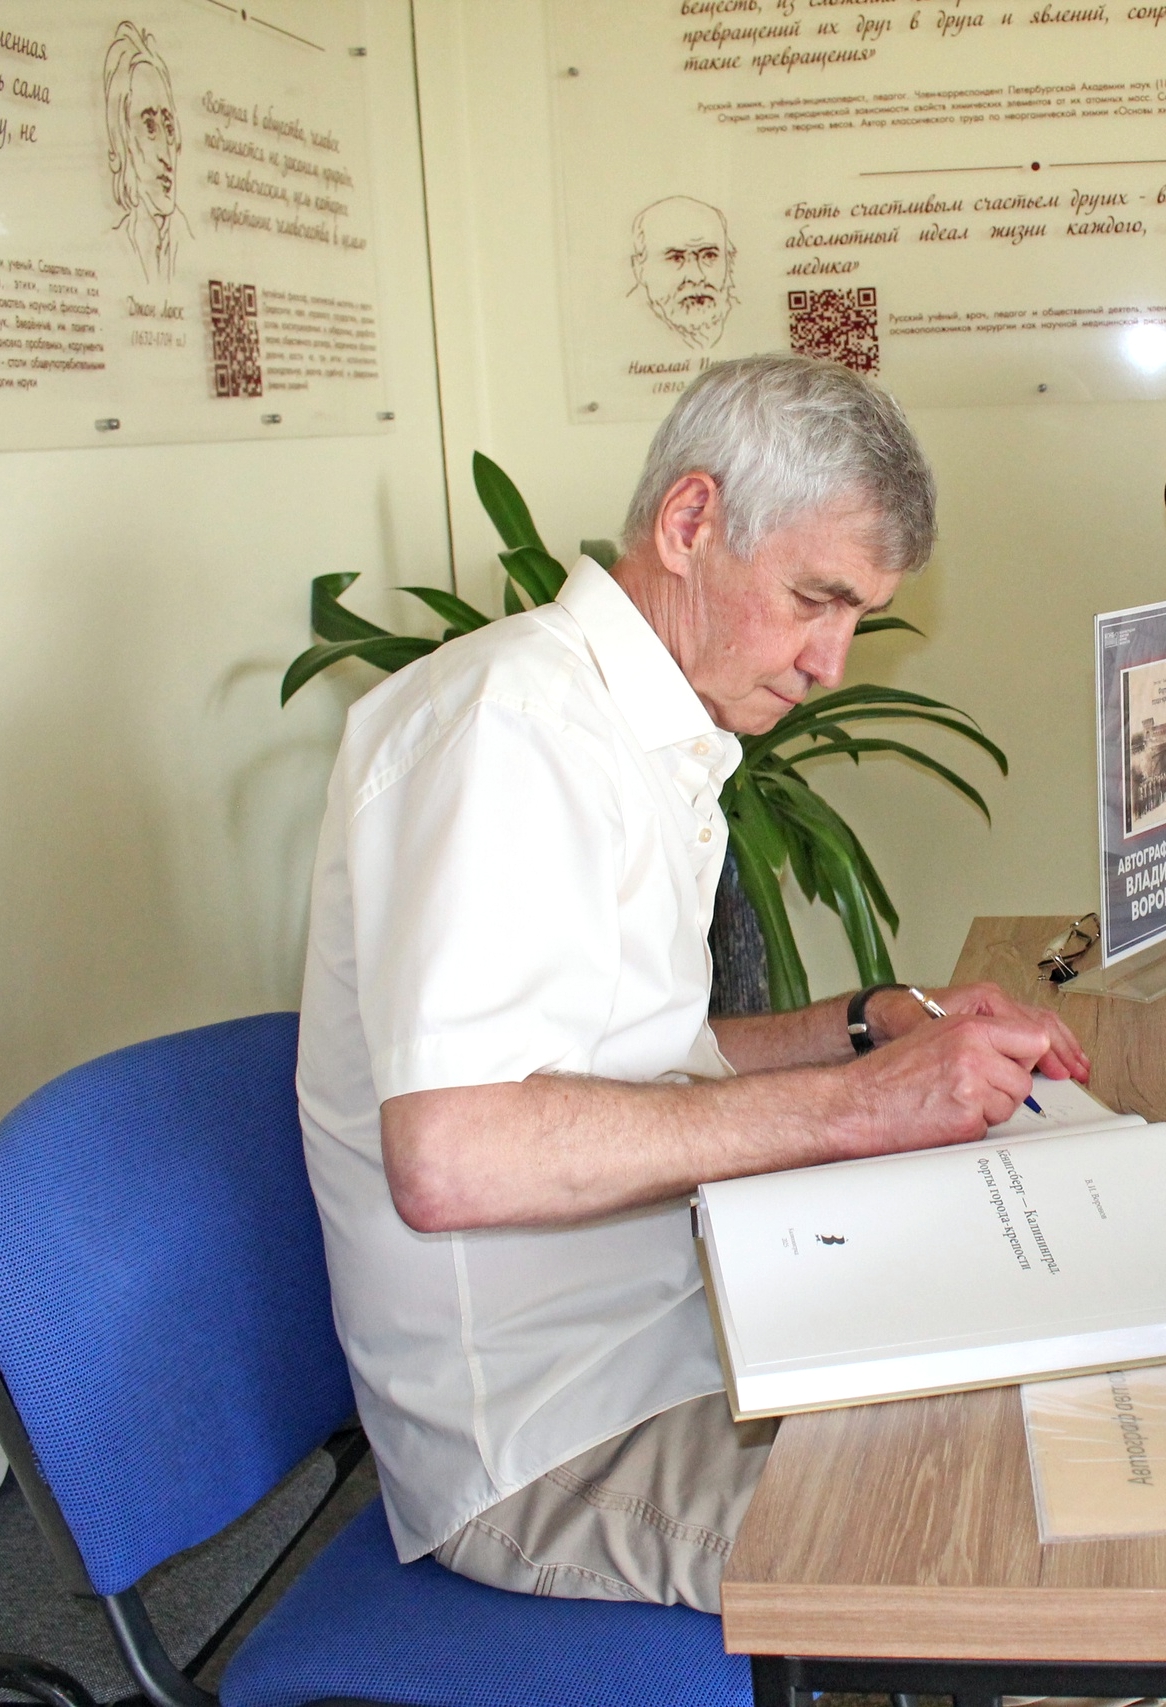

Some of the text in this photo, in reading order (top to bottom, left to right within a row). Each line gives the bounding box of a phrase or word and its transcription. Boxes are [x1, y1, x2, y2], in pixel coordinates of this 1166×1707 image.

[682, 20, 801, 50] превращений
[818, 21, 840, 35] их
[856, 14, 893, 40] друг
[909, 10, 920, 30] в
[937, 10, 985, 37] друга
[1001, 12, 1013, 25] и
[1030, 4, 1110, 25] явлений,
[684, 47, 877, 75] такие превращения»
[13, 78, 50, 104] сама
[698, 101, 732, 113] Русский
[1008, 83, 1076, 95] Петербургской
[1080, 82, 1125, 92] Академии
[1130, 83, 1150, 91] наук
[718, 113, 750, 123] Открыл
[784, 107, 850, 119] периодической
[914, 103, 946, 112] свойств
[861, 118, 886, 128] Автор
[891, 115, 955, 126] классического
[959, 114, 984, 124] труда
[21, 124, 37, 142] не
[785, 202, 840, 220] «Быть
[850, 194, 963, 217] счастливым
[974, 194, 1059, 212] счастьем
[1071, 189, 1128, 215] других
[785, 225, 900, 249] абсолютный
[919, 222, 969, 243] идеал
[990, 224, 1047, 245] жизни
[1066, 214, 1147, 236] каждого,
[786, 257, 860, 276] медика»
[889, 312, 923, 324] Русский
[994, 310, 1027, 319] педагог
[1042, 305, 1104, 317] общественный
[1041, 319, 1077, 329] научной
[628, 359, 691, 375] Николай
[977, 1158, 1031, 1270] Форты города-крепости
[1023, 1209, 1060, 1275] Калининград.
[1110, 1413, 1154, 1486] Автограф
